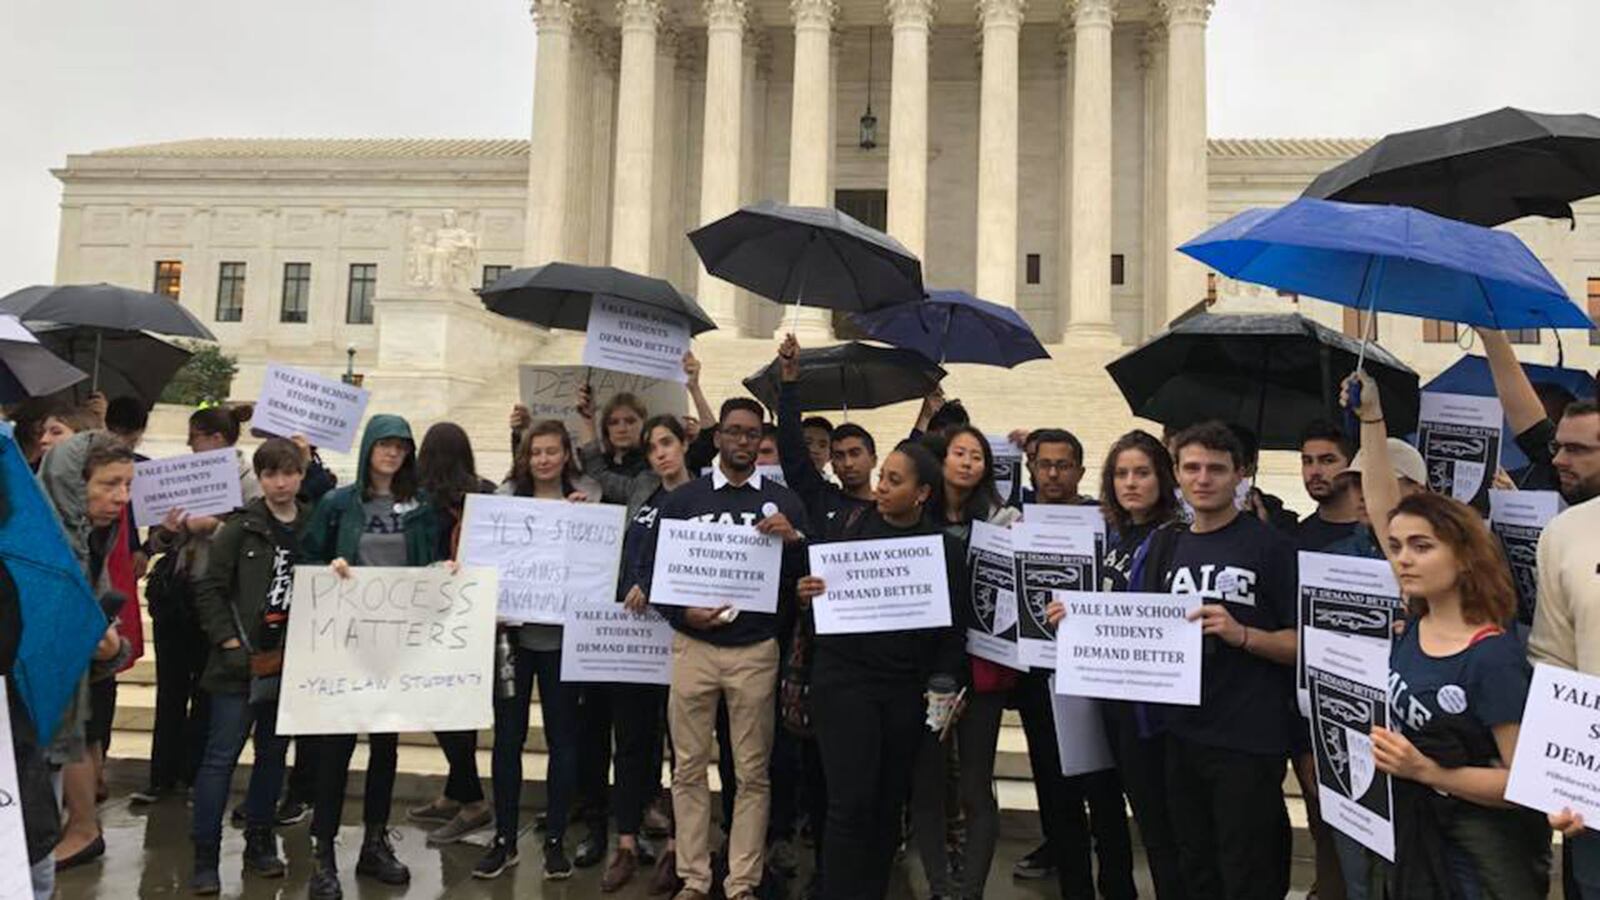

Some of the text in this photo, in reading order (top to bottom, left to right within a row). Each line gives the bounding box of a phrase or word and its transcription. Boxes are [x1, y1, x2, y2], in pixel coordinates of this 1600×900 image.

[618, 319, 669, 338] STUDENTS
[600, 332, 643, 349] DEMAND
[644, 341, 683, 356] BETTER
[267, 397, 308, 417] DEMAND
[160, 472, 211, 486] STUDENTS
[144, 489, 188, 502] DEMAND
[189, 482, 228, 495] BETTER
[669, 528, 773, 548] YALE LAW SCHOOL
[688, 547, 748, 562] STUDENTS
[821, 546, 933, 565] YALE LAW SCHOOL
[667, 563, 765, 582] DEMAND BETTER
[846, 565, 911, 581] STUDENTS
[311, 574, 479, 616] PROCESS
[827, 583, 933, 601] DEMAND BETTER
[1165, 564, 1257, 608] ALE
[1319, 589, 1365, 603] DEMAND
[575, 611, 604, 620] YALE
[605, 611, 629, 621] LAW
[1071, 602, 1101, 616] YALE
[1104, 604, 1135, 617] LAW
[310, 617, 469, 653] MATTERS
[596, 626, 653, 638] STUDENTS
[1094, 624, 1164, 640] STUDENTS
[576, 642, 669, 656] DEMAND BETTER
[1073, 645, 1186, 664] DEMAND BETTER
[352, 678, 390, 692] LAW
